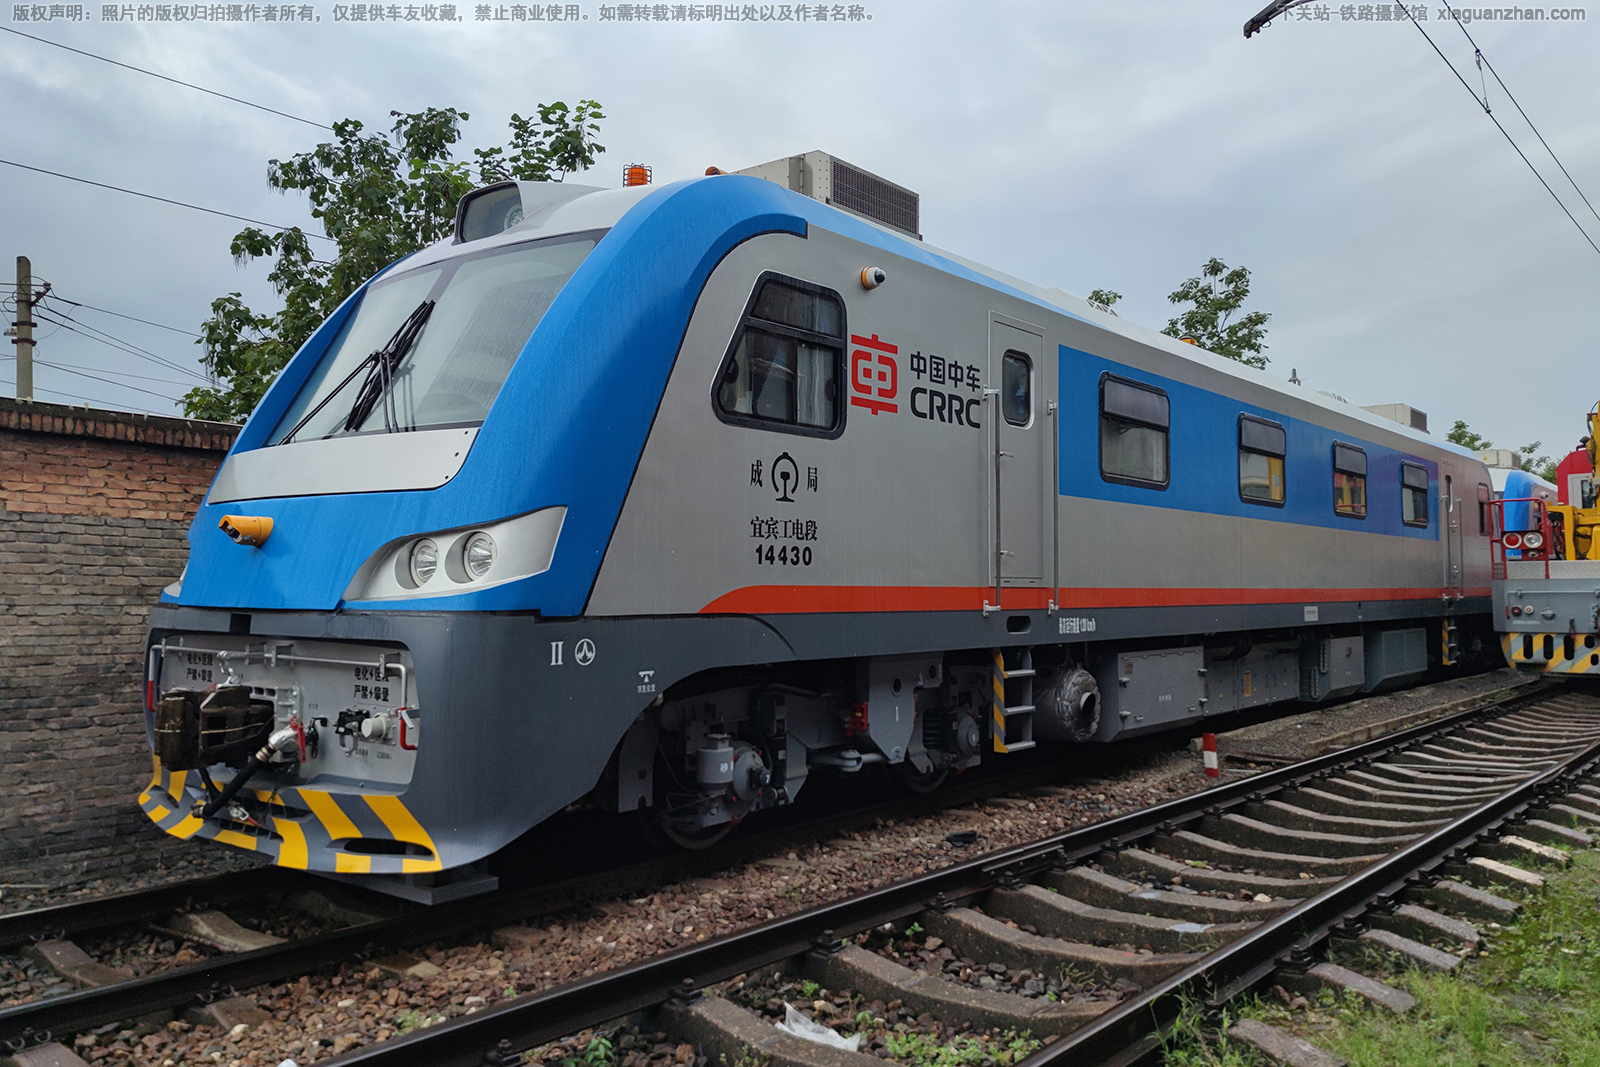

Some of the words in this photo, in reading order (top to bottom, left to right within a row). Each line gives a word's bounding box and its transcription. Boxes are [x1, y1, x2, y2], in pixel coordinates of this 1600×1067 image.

[910, 351, 981, 392] 中国中车
[910, 387, 981, 429] CRRC
[750, 460, 763, 487] 成
[807, 467, 818, 492] 局
[750, 516, 818, 541] 宜宾工电段
[755, 544, 812, 566] 14430
